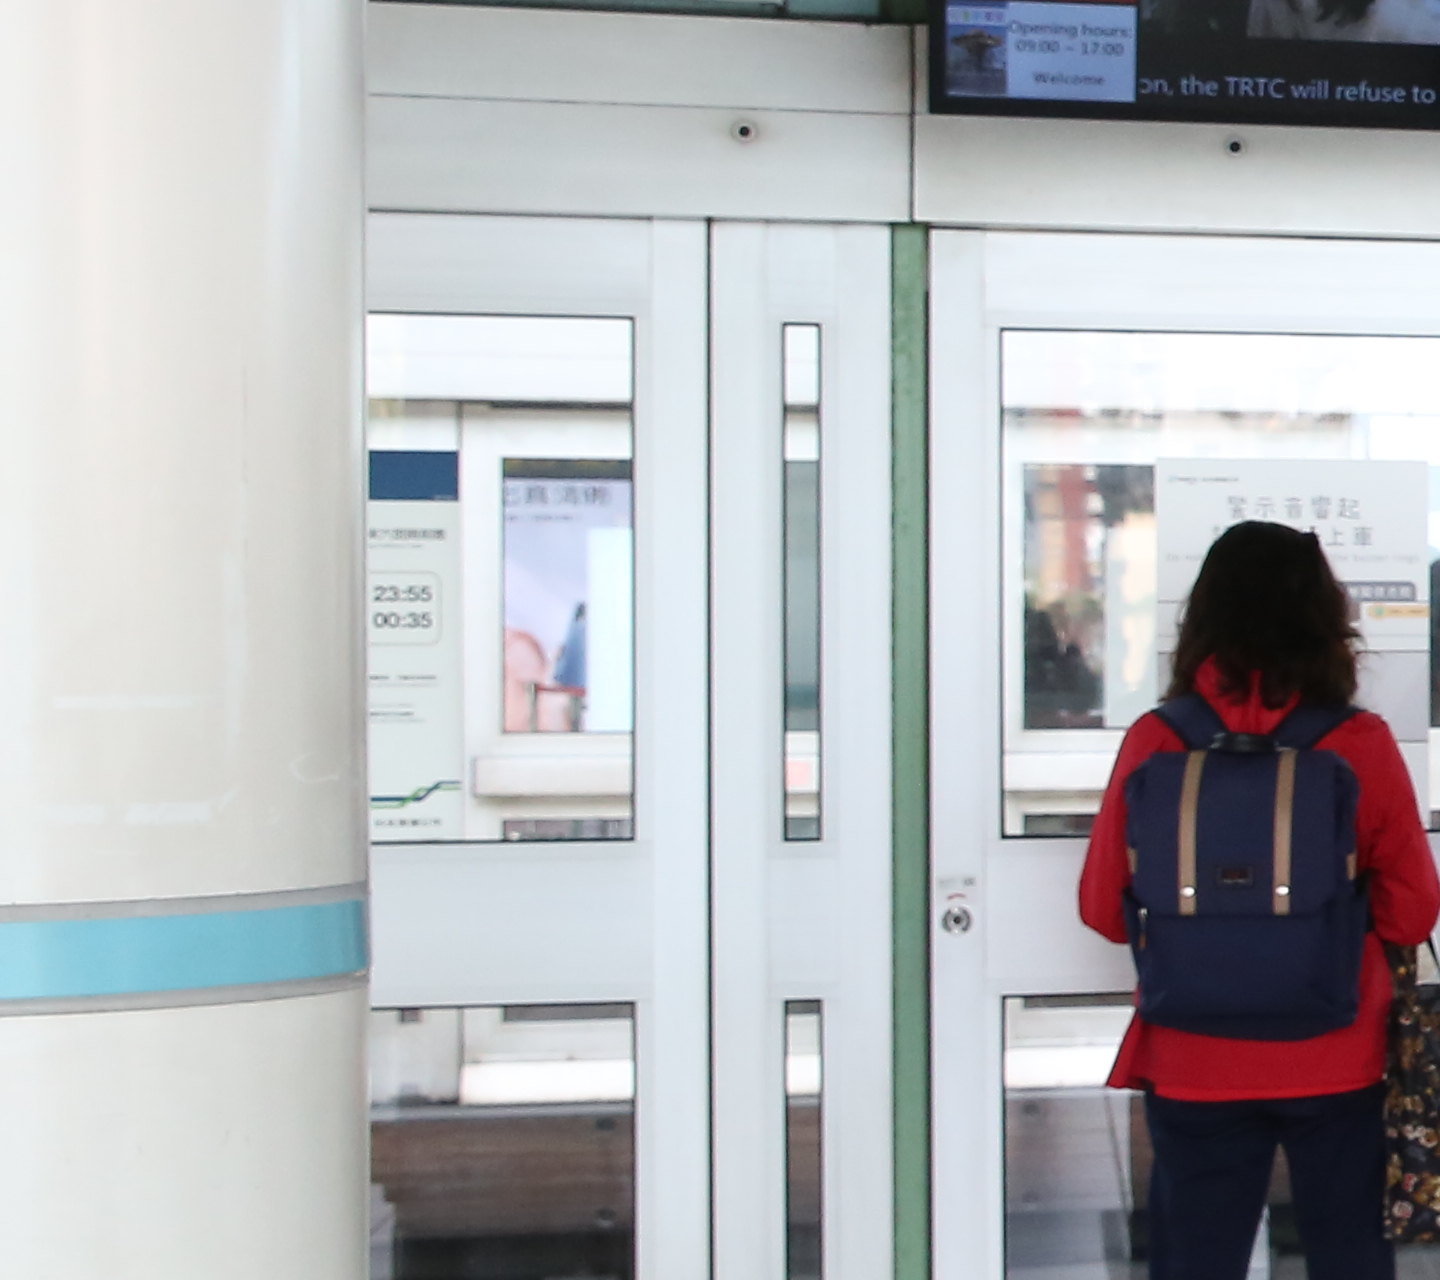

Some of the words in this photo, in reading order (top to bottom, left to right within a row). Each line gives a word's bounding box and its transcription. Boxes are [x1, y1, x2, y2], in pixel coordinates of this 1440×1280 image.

[1180, 74, 1219, 97] the
[1224, 76, 1287, 100] TRTC
[1291, 79, 1330, 100] will
[1335, 80, 1407, 104] refuse
[1411, 85, 1436, 104] to
[373, 586, 433, 603] 23:55
[373, 612, 433, 629] 00:35
